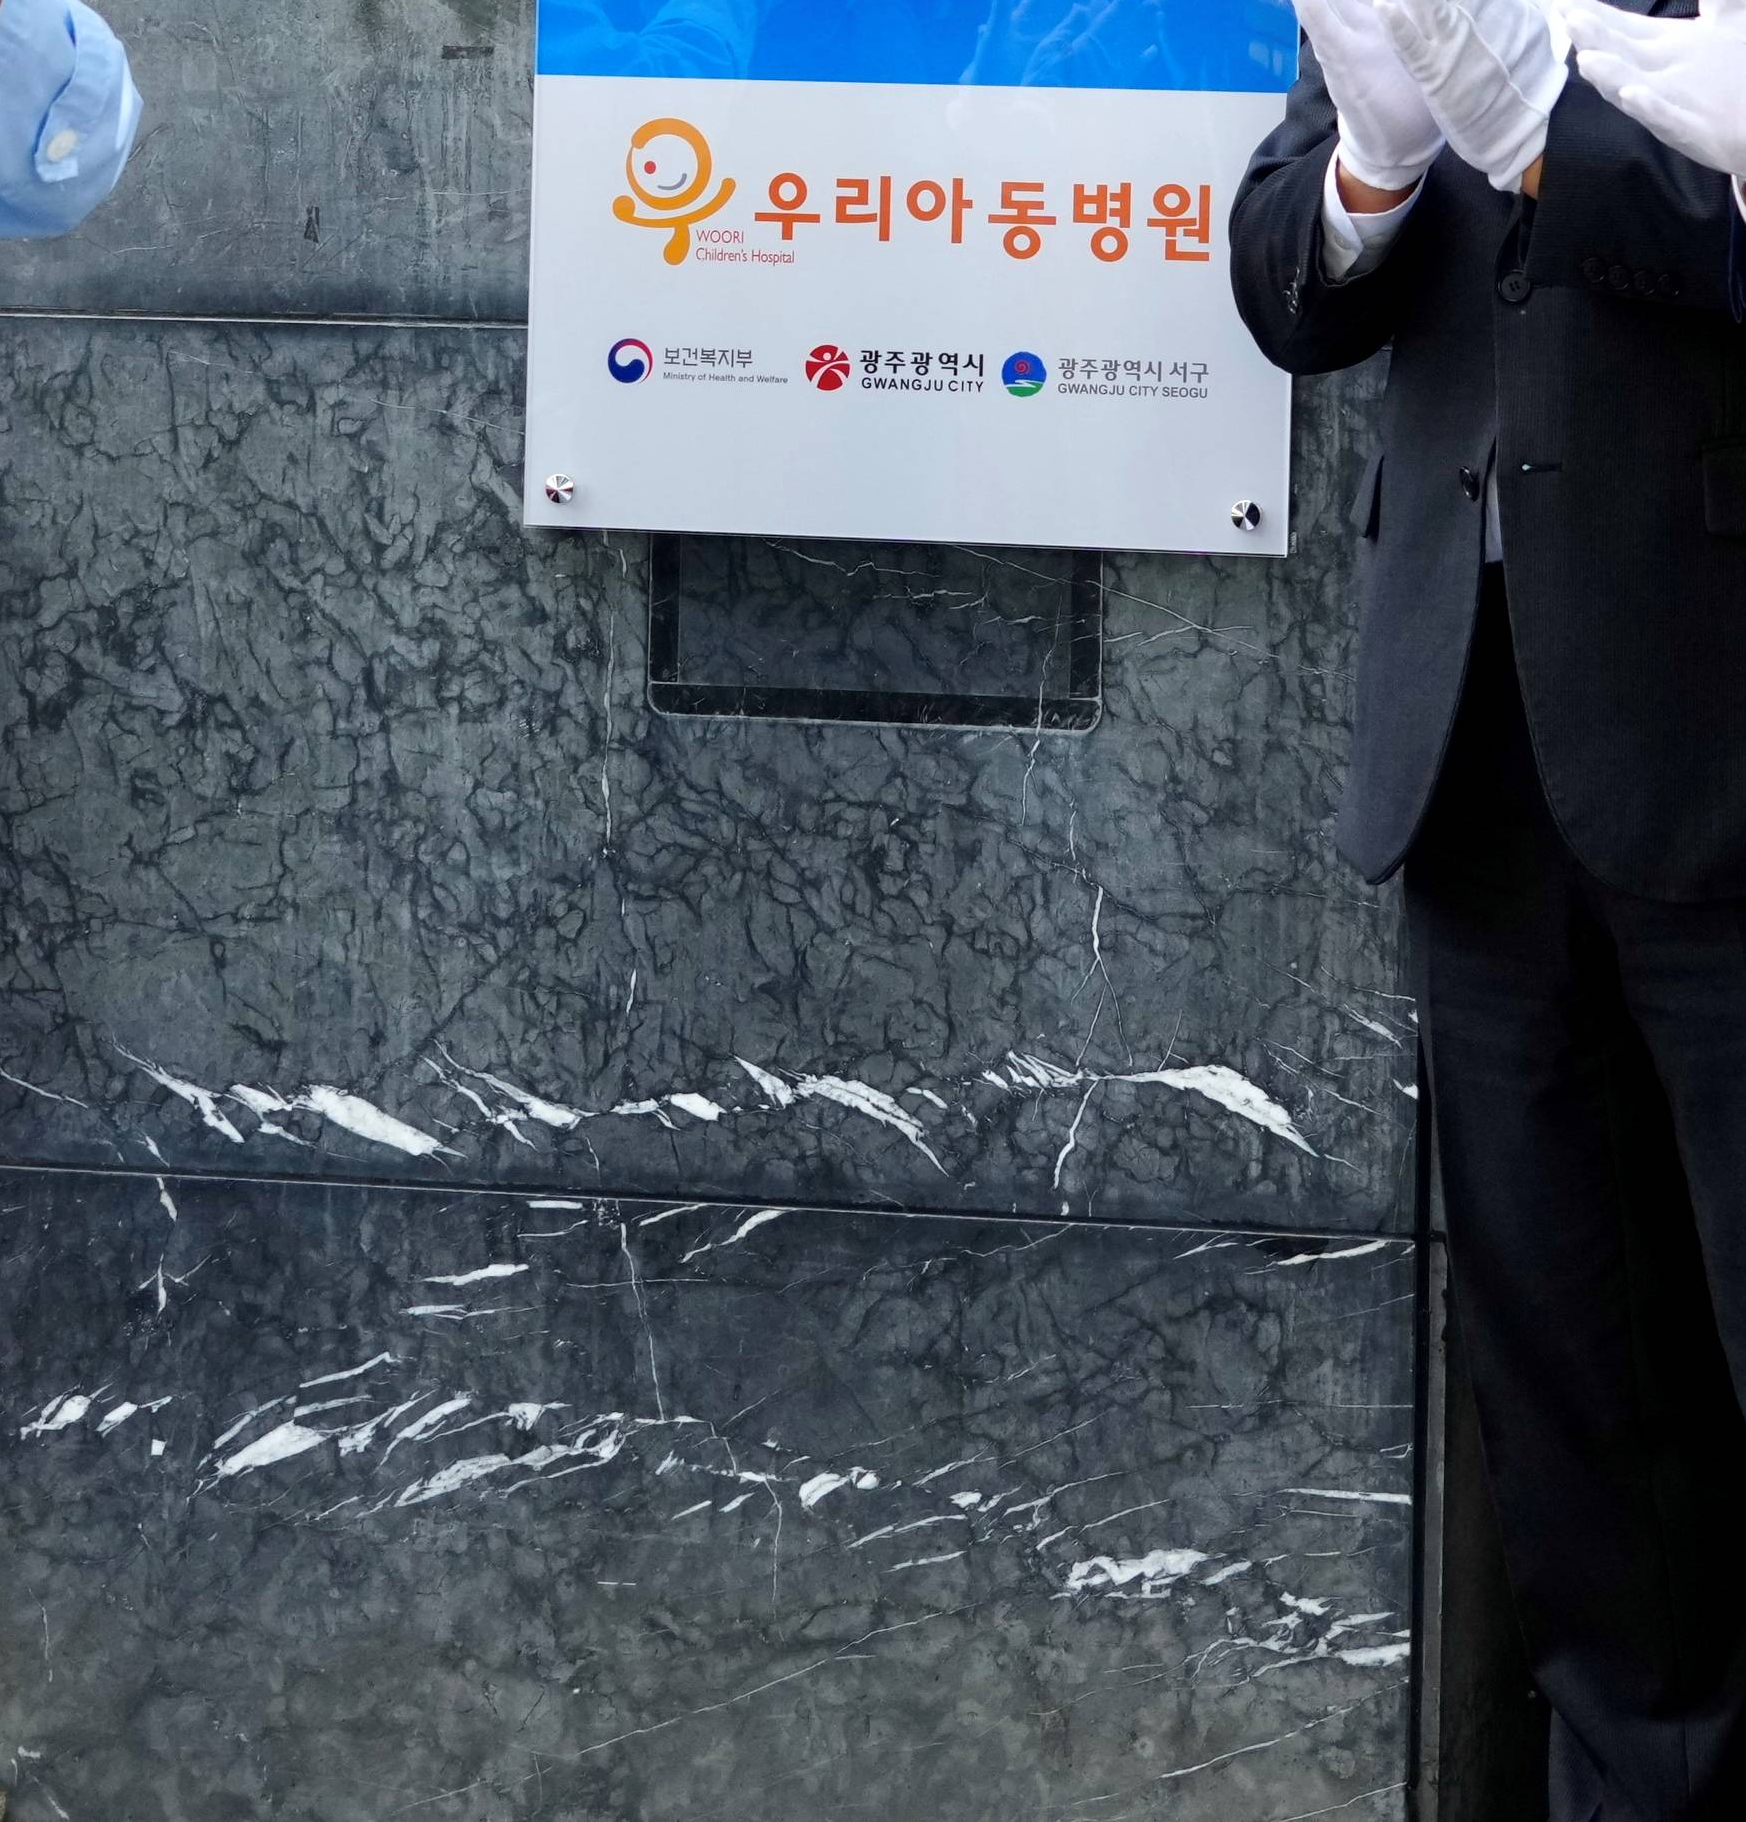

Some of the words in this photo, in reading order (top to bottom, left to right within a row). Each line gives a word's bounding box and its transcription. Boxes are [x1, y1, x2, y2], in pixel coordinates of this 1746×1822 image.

[754, 171, 1212, 263] 우리아동병원
[695, 229, 744, 244] WOORI
[695, 247, 748, 264] Children's
[751, 250, 795, 266] Hospital
[663, 347, 754, 369] 보건복지부
[859, 349, 984, 377] 광주광역시
[662, 371, 696, 382] Ministry
[697, 373, 708, 381] of
[708, 373, 736, 383] Health
[738, 375, 755, 383] and
[756, 375, 789, 384] Welfare
[1058, 357, 1163, 383] 광주광역시
[1169, 361, 1210, 384] 서구
[860, 377, 944, 392] GWANGJU
[947, 380, 984, 393] CITY
[1057, 382, 1125, 396] GWANGJU
[1128, 385, 1159, 397] CITY
[1161, 386, 1208, 399] SEOGU
